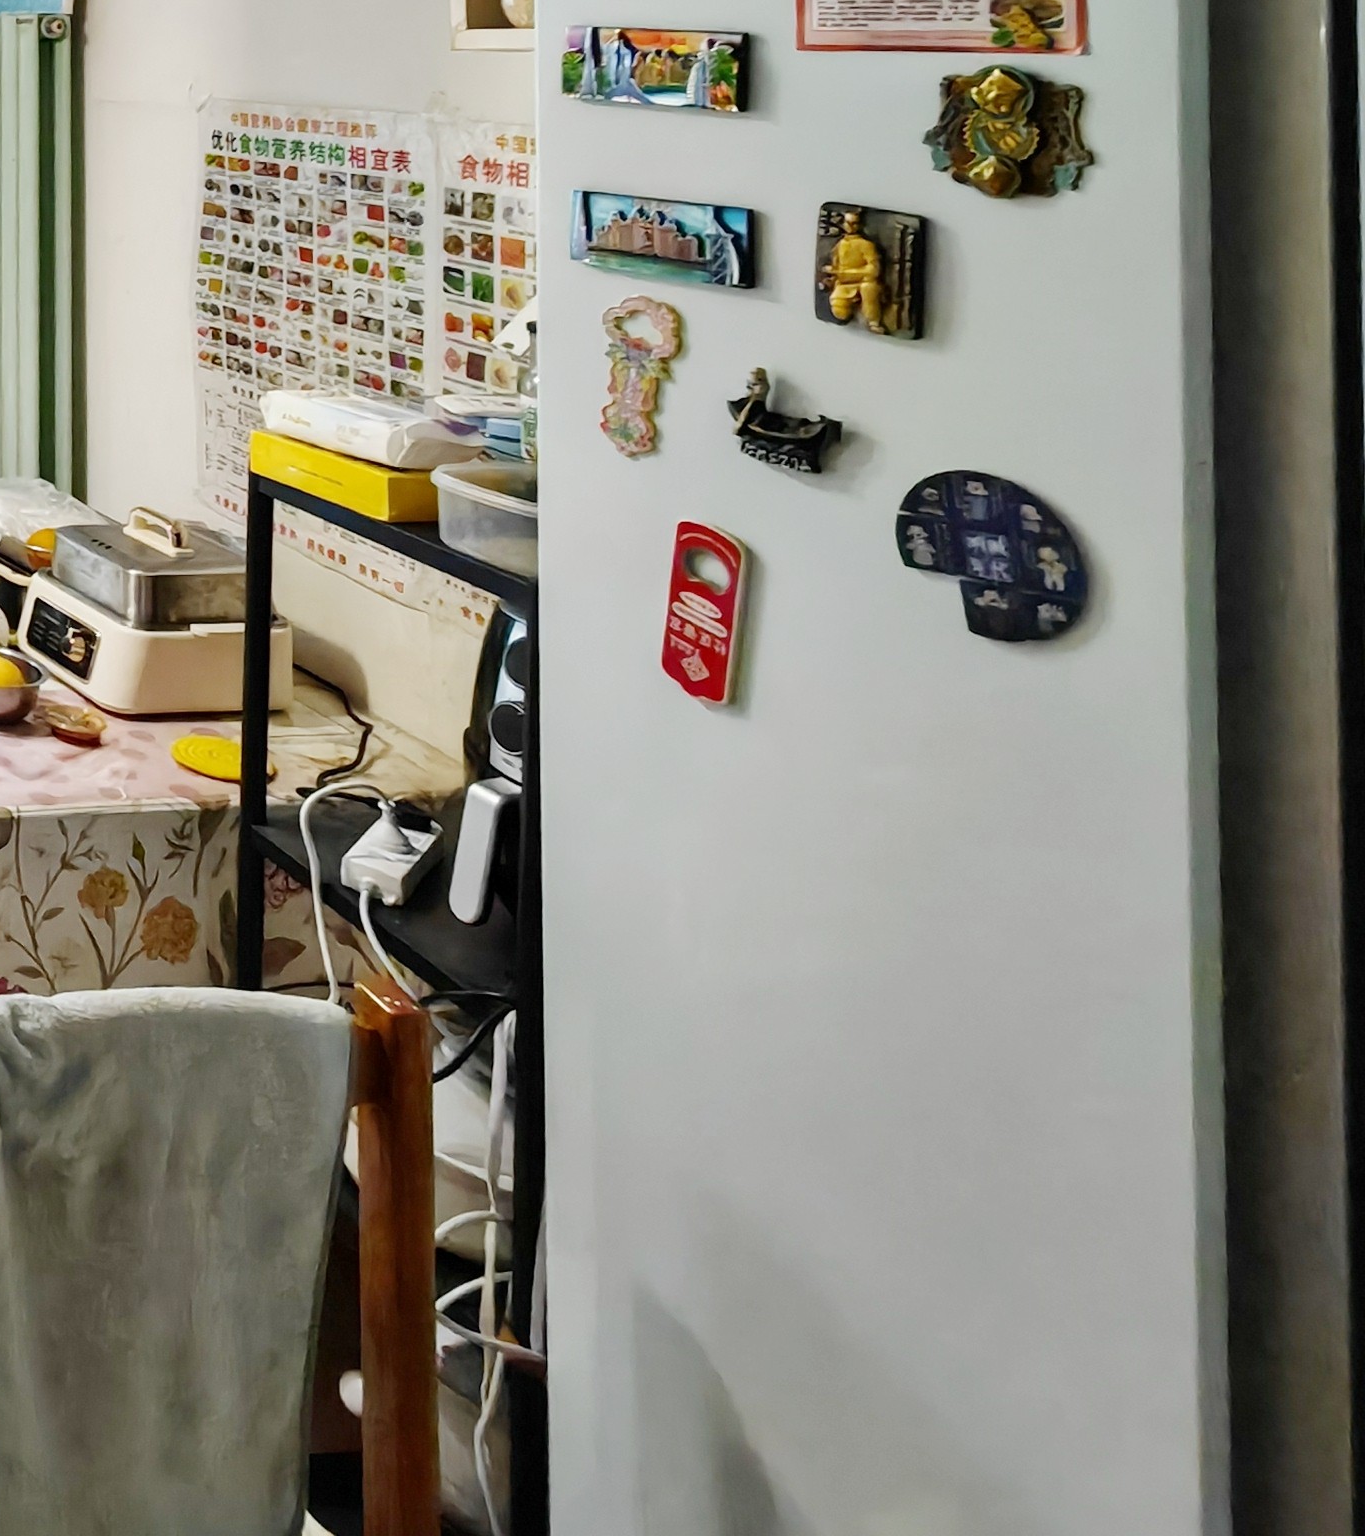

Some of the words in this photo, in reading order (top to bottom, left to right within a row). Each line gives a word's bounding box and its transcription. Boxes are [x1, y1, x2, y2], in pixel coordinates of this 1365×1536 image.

[211, 129, 413, 174] 优化食物营养结构相宜表
[458, 155, 531, 188] 食物相
